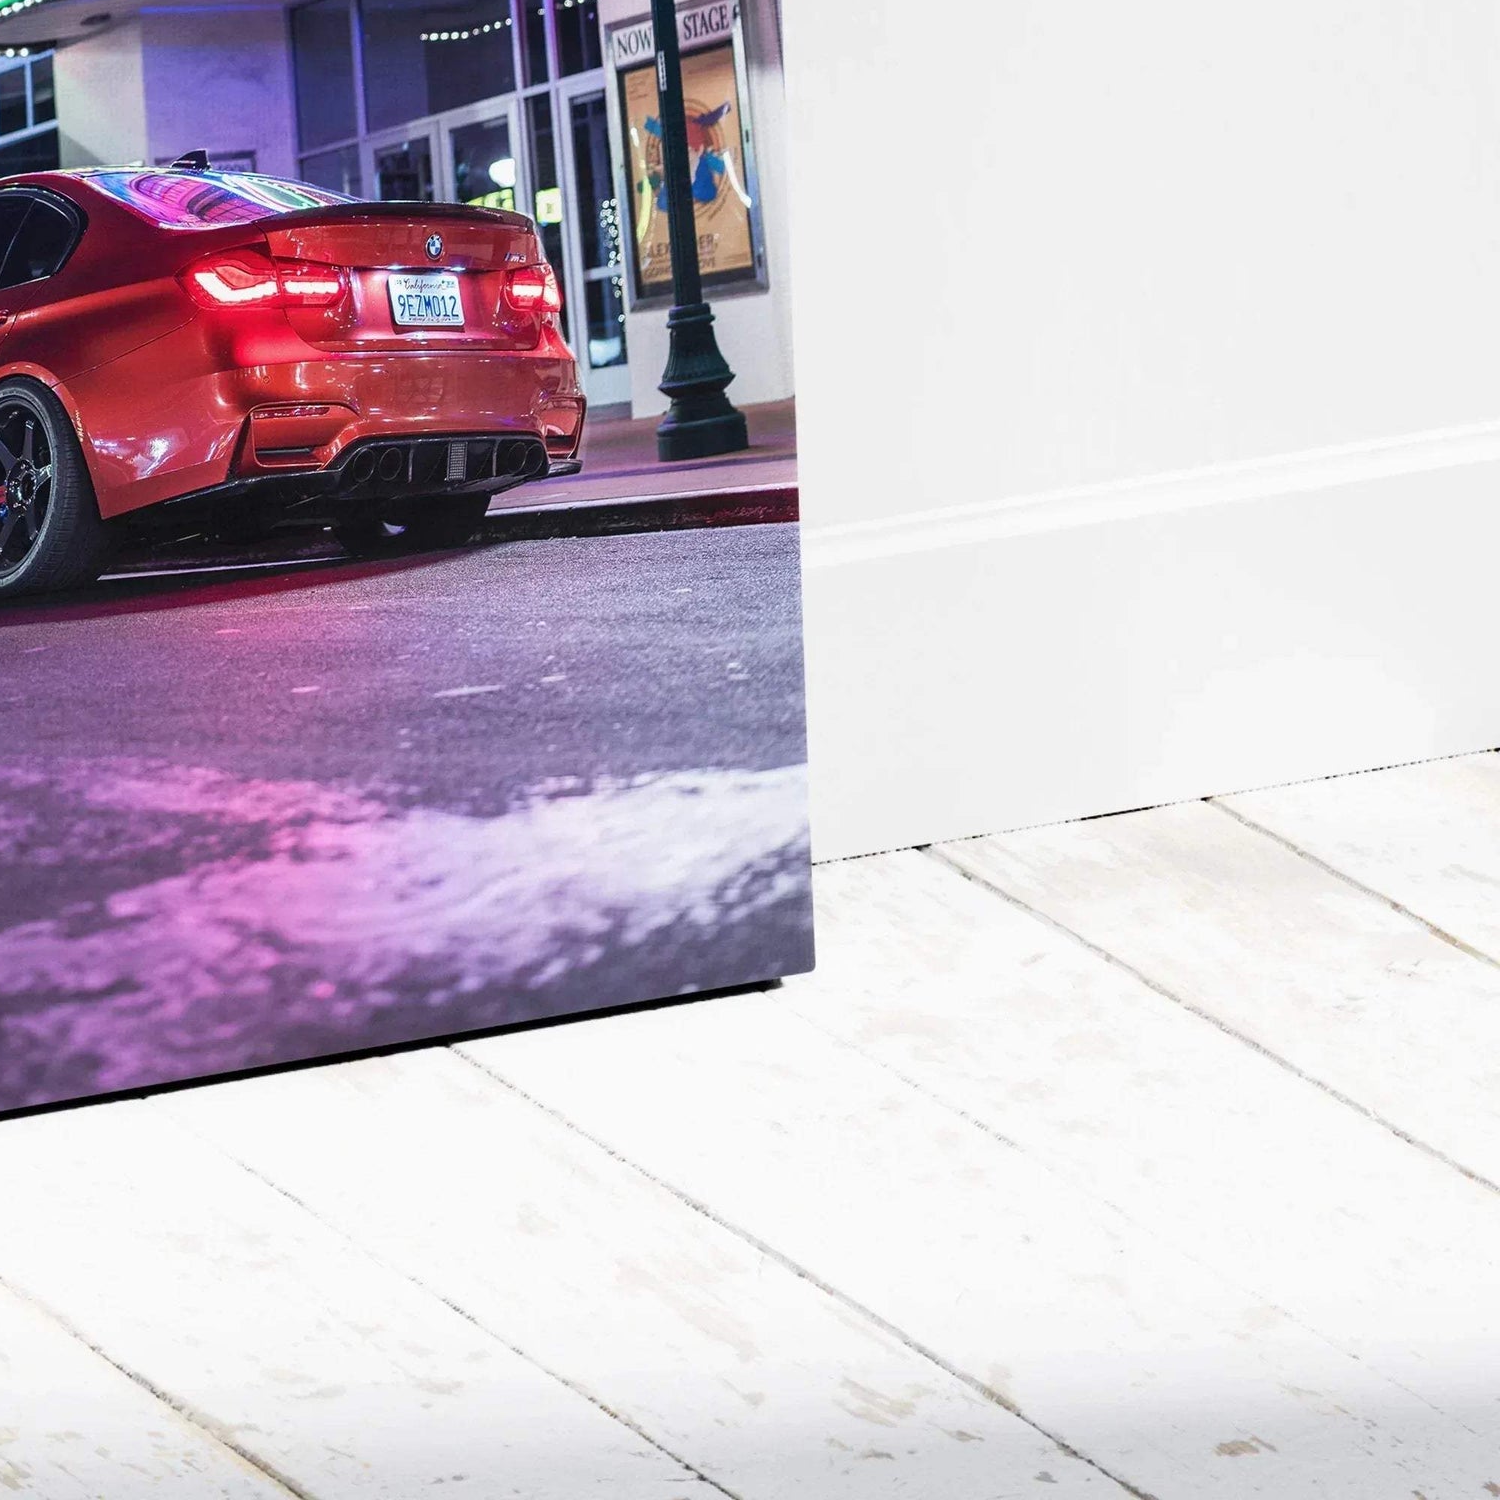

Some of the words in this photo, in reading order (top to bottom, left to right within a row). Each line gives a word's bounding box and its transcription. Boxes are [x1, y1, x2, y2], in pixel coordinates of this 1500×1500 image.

[617, 26, 653, 59] NOW
[682, 4, 730, 41] STAGE
[403, 278, 443, 293] California
[397, 294, 460, 318] 9EZM012
